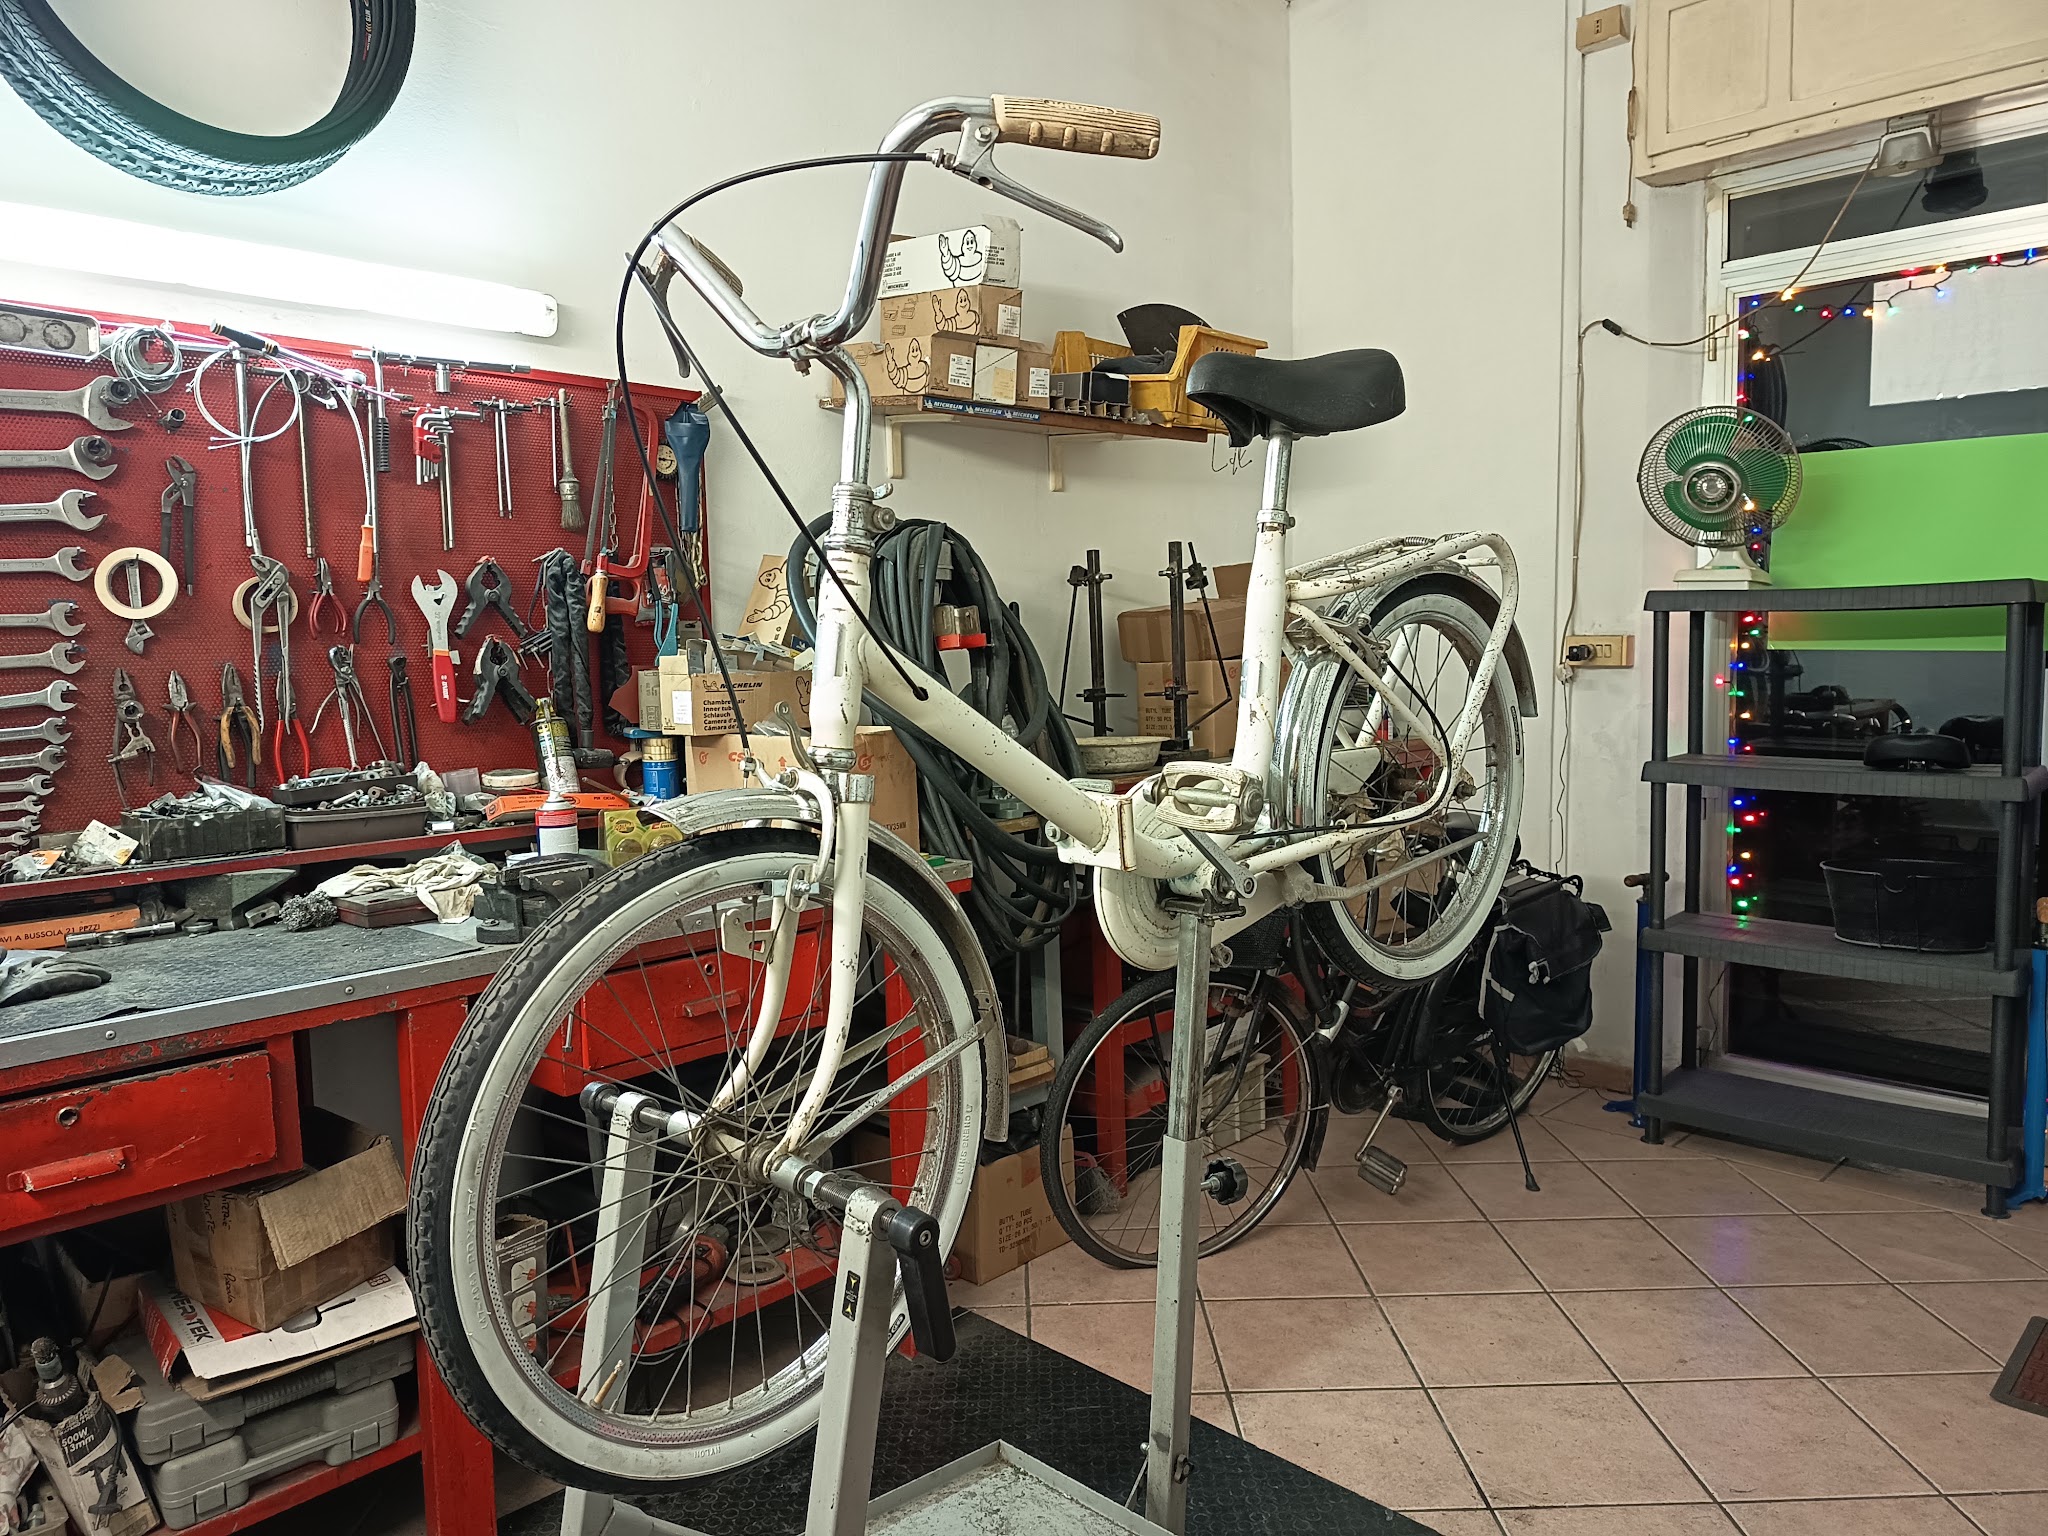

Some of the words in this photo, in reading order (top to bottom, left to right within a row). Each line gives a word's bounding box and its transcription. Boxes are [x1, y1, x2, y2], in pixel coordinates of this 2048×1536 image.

[933, 401, 963, 410] MICHELIN
[975, 406, 1002, 415] MICHELIN
[1013, 411, 1040, 419] MICHELIN
[720, 682, 763, 690] MCHELIN
[703, 711, 731, 719] Schlauch
[728, 752, 754, 763] CS
[24, 929, 63, 940] BUSSOLA
[998, 1214, 1015, 1227] BUTYL
[1020, 1206, 1033, 1218] TUBE
[1023, 1216, 1033, 1226] PCS
[61, 1426, 88, 1447] 500W
